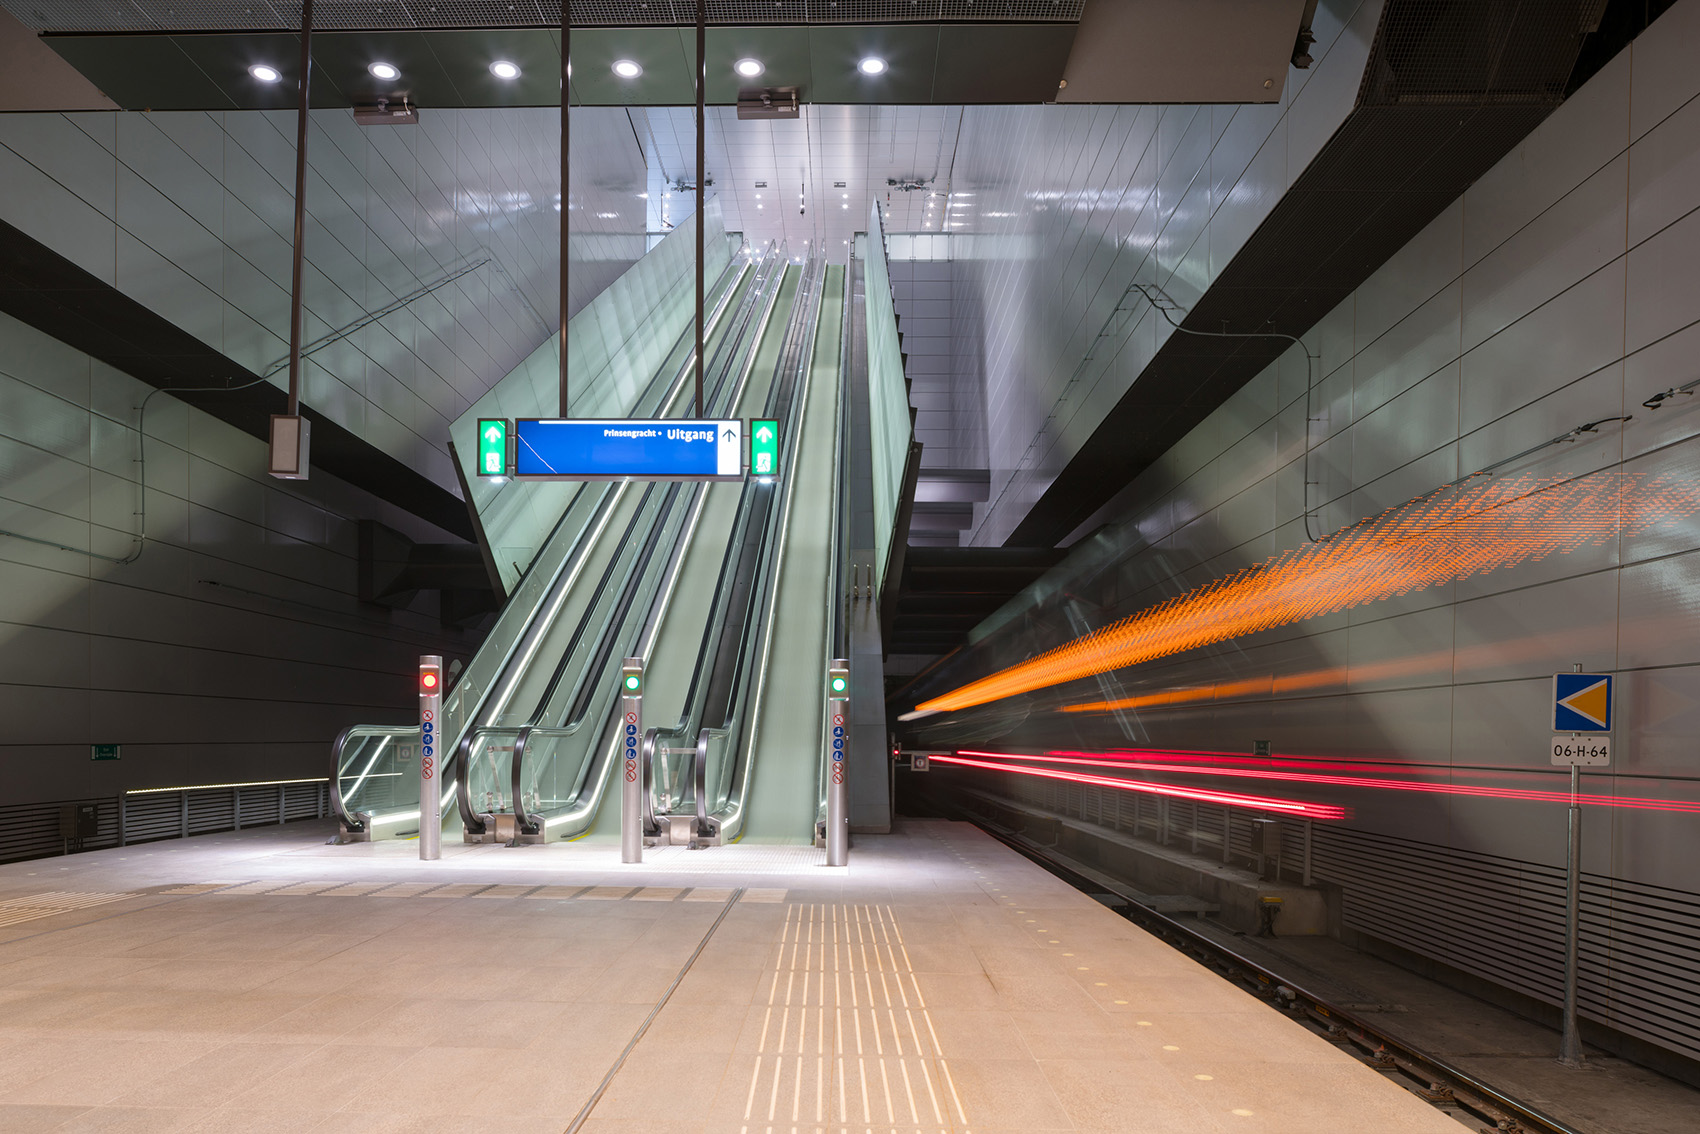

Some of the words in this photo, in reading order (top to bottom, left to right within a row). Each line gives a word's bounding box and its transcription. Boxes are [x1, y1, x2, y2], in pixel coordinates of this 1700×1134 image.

[603, 429, 657, 439] Prinsengracht
[667, 428, 715, 443] Uitgang
[1553, 744, 1608, 758] 06-H-64
